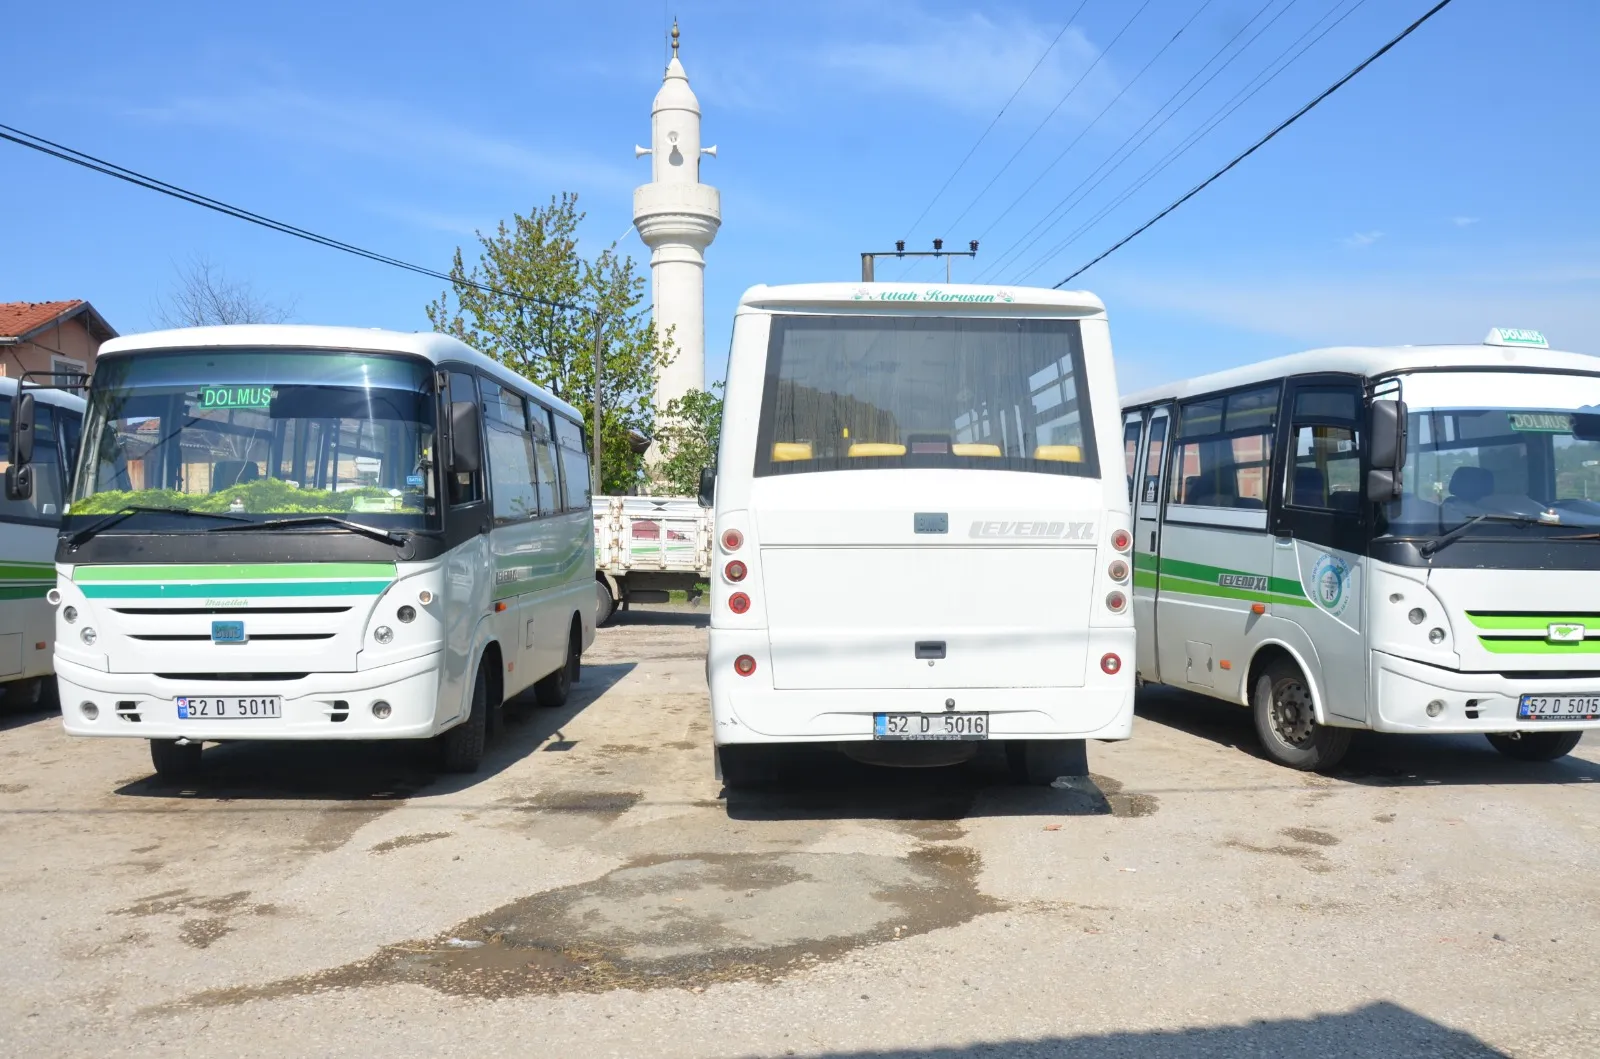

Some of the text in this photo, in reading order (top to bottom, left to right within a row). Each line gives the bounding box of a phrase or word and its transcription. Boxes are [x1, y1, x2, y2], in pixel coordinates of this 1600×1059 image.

[923, 288, 995, 303] Korusun
[1501, 328, 1544, 344] DOLMUŞ
[204, 387, 272, 407] DOLMUŞ
[1514, 414, 1570, 430] DOLMUŞ
[968, 520, 1095, 540] LEVEND XL
[1218, 574, 1267, 591] LEVEND XL
[188, 699, 209, 716] 52
[216, 699, 225, 716] D
[238, 698, 275, 716] 5011
[1530, 698, 1547, 714] 52
[1553, 698, 1561, 714] D
[1567, 698, 1599, 714] 5015
[888, 715, 909, 733] 52
[920, 715, 930, 733] D
[944, 716, 984, 734] 5016
